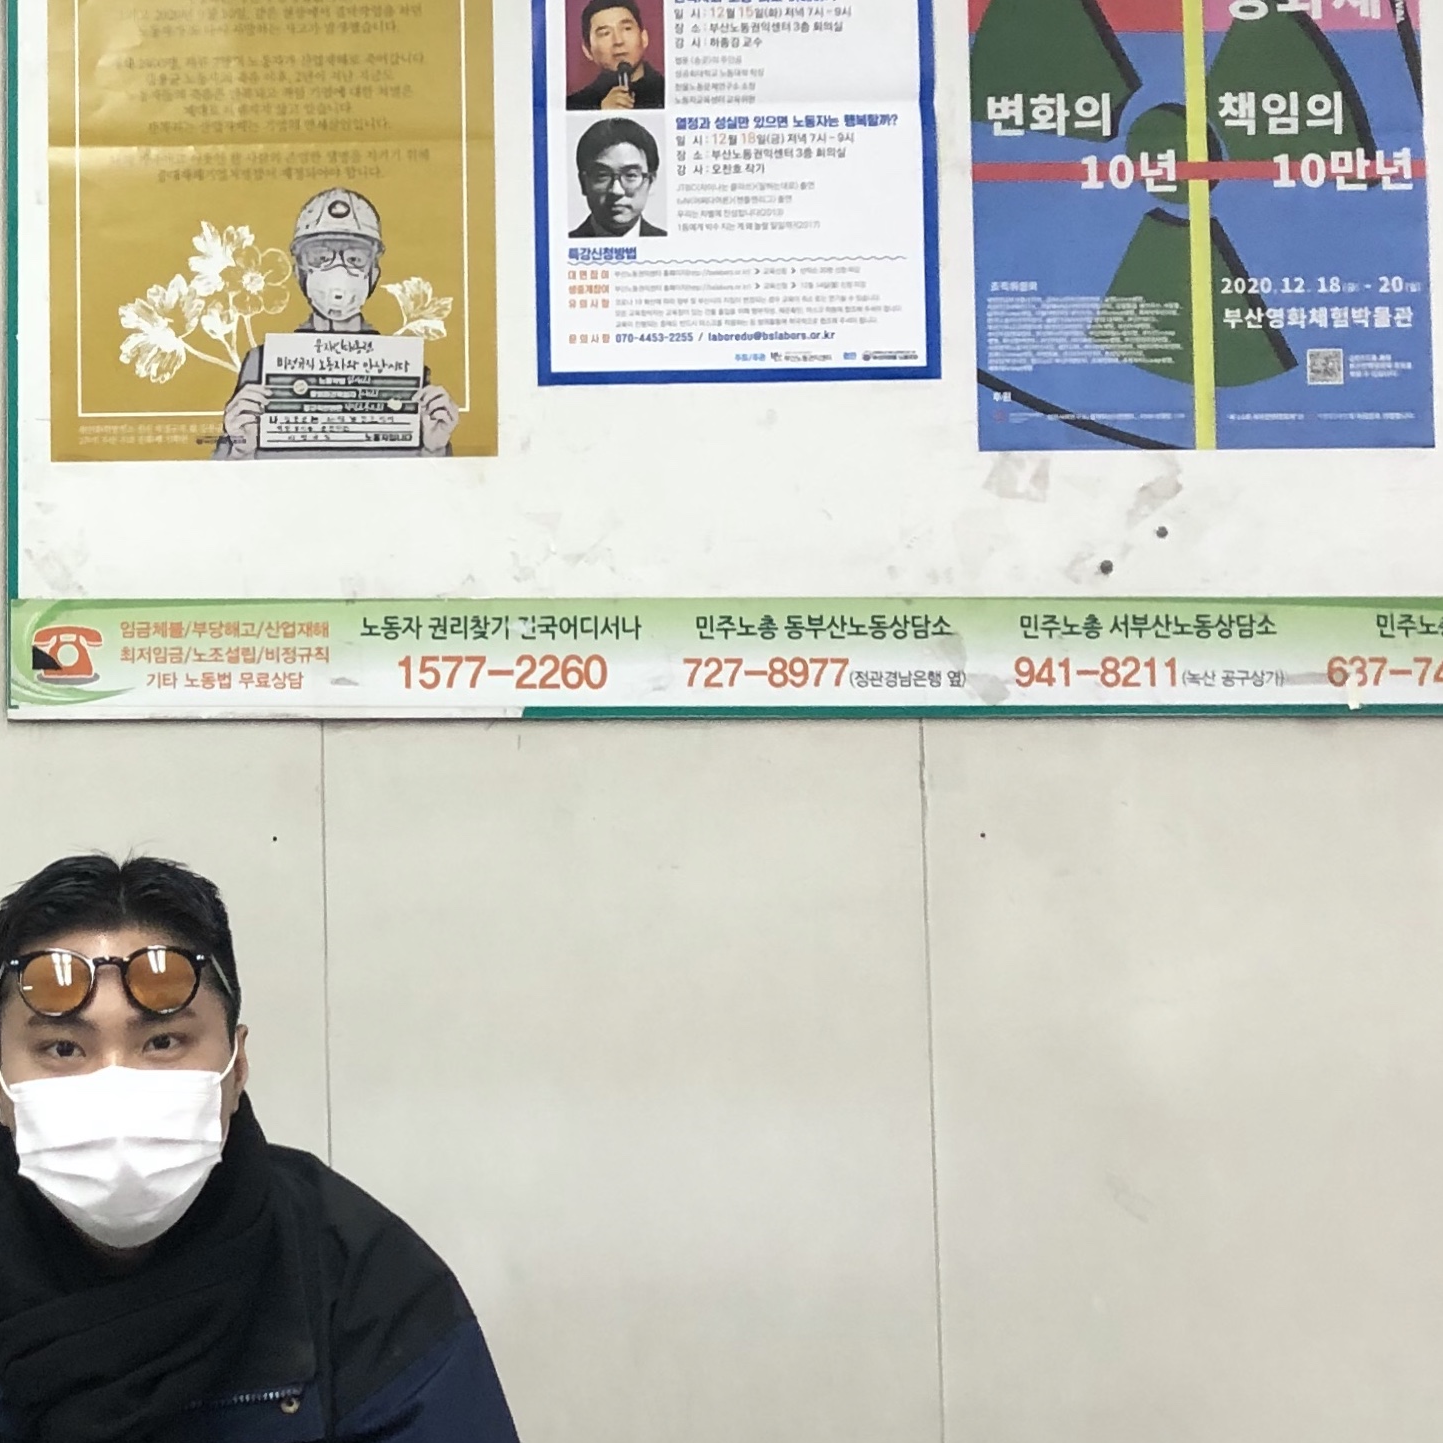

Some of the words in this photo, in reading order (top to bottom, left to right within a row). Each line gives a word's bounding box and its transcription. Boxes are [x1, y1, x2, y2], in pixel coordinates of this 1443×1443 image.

[710, 6, 735, 18] 12월
[808, 6, 824, 17] 7시
[835, 6, 852, 17] 9시
[710, 21, 791, 33] 부산노동권익센터
[813, 20, 843, 32] 회의실
[675, 117, 710, 130] 열정과
[714, 117, 748, 129] 성실만
[753, 116, 788, 128] 있으면
[793, 115, 839, 128] 노동자는
[987, 93, 1111, 136] 변화의
[1218, 91, 1343, 135] 책임의
[712, 133, 737, 145] 12월
[741, 132, 784, 145] 18일(금)
[810, 133, 827, 143] 7시
[837, 132, 854, 143] 9시
[711, 148, 794, 160] 부산노동권익센터
[816, 147, 846, 158] 회의실
[745, 162, 765, 174] 작가
[1081, 150, 1177, 192] 10년
[1273, 147, 1413, 191] 10만년
[1223, 306, 1413, 328] 부산영화체험박물관
[615, 333, 694, 343] 070-4453-2255
[120, 621, 329, 639] 임금체불/부당해고/산업재해
[360, 615, 422, 640] 노동자
[428, 615, 509, 640] 권리찾기
[696, 614, 778, 640] 민주노총
[784, 614, 955, 640] 동부산노동상담소
[1020, 614, 1103, 639] 민주노총
[1109, 613, 1277, 639] 서부산노동상담소
[1376, 612, 1443, 638] 민주노
[120, 645, 330, 664] 최저임금/노조설립/비정규직
[146, 672, 178, 690] 기타
[184, 672, 232, 690] 노동법
[238, 672, 304, 690] 무료상담
[398, 654, 608, 690] 1577-2260
[1014, 656, 1177, 688] 941-8211
